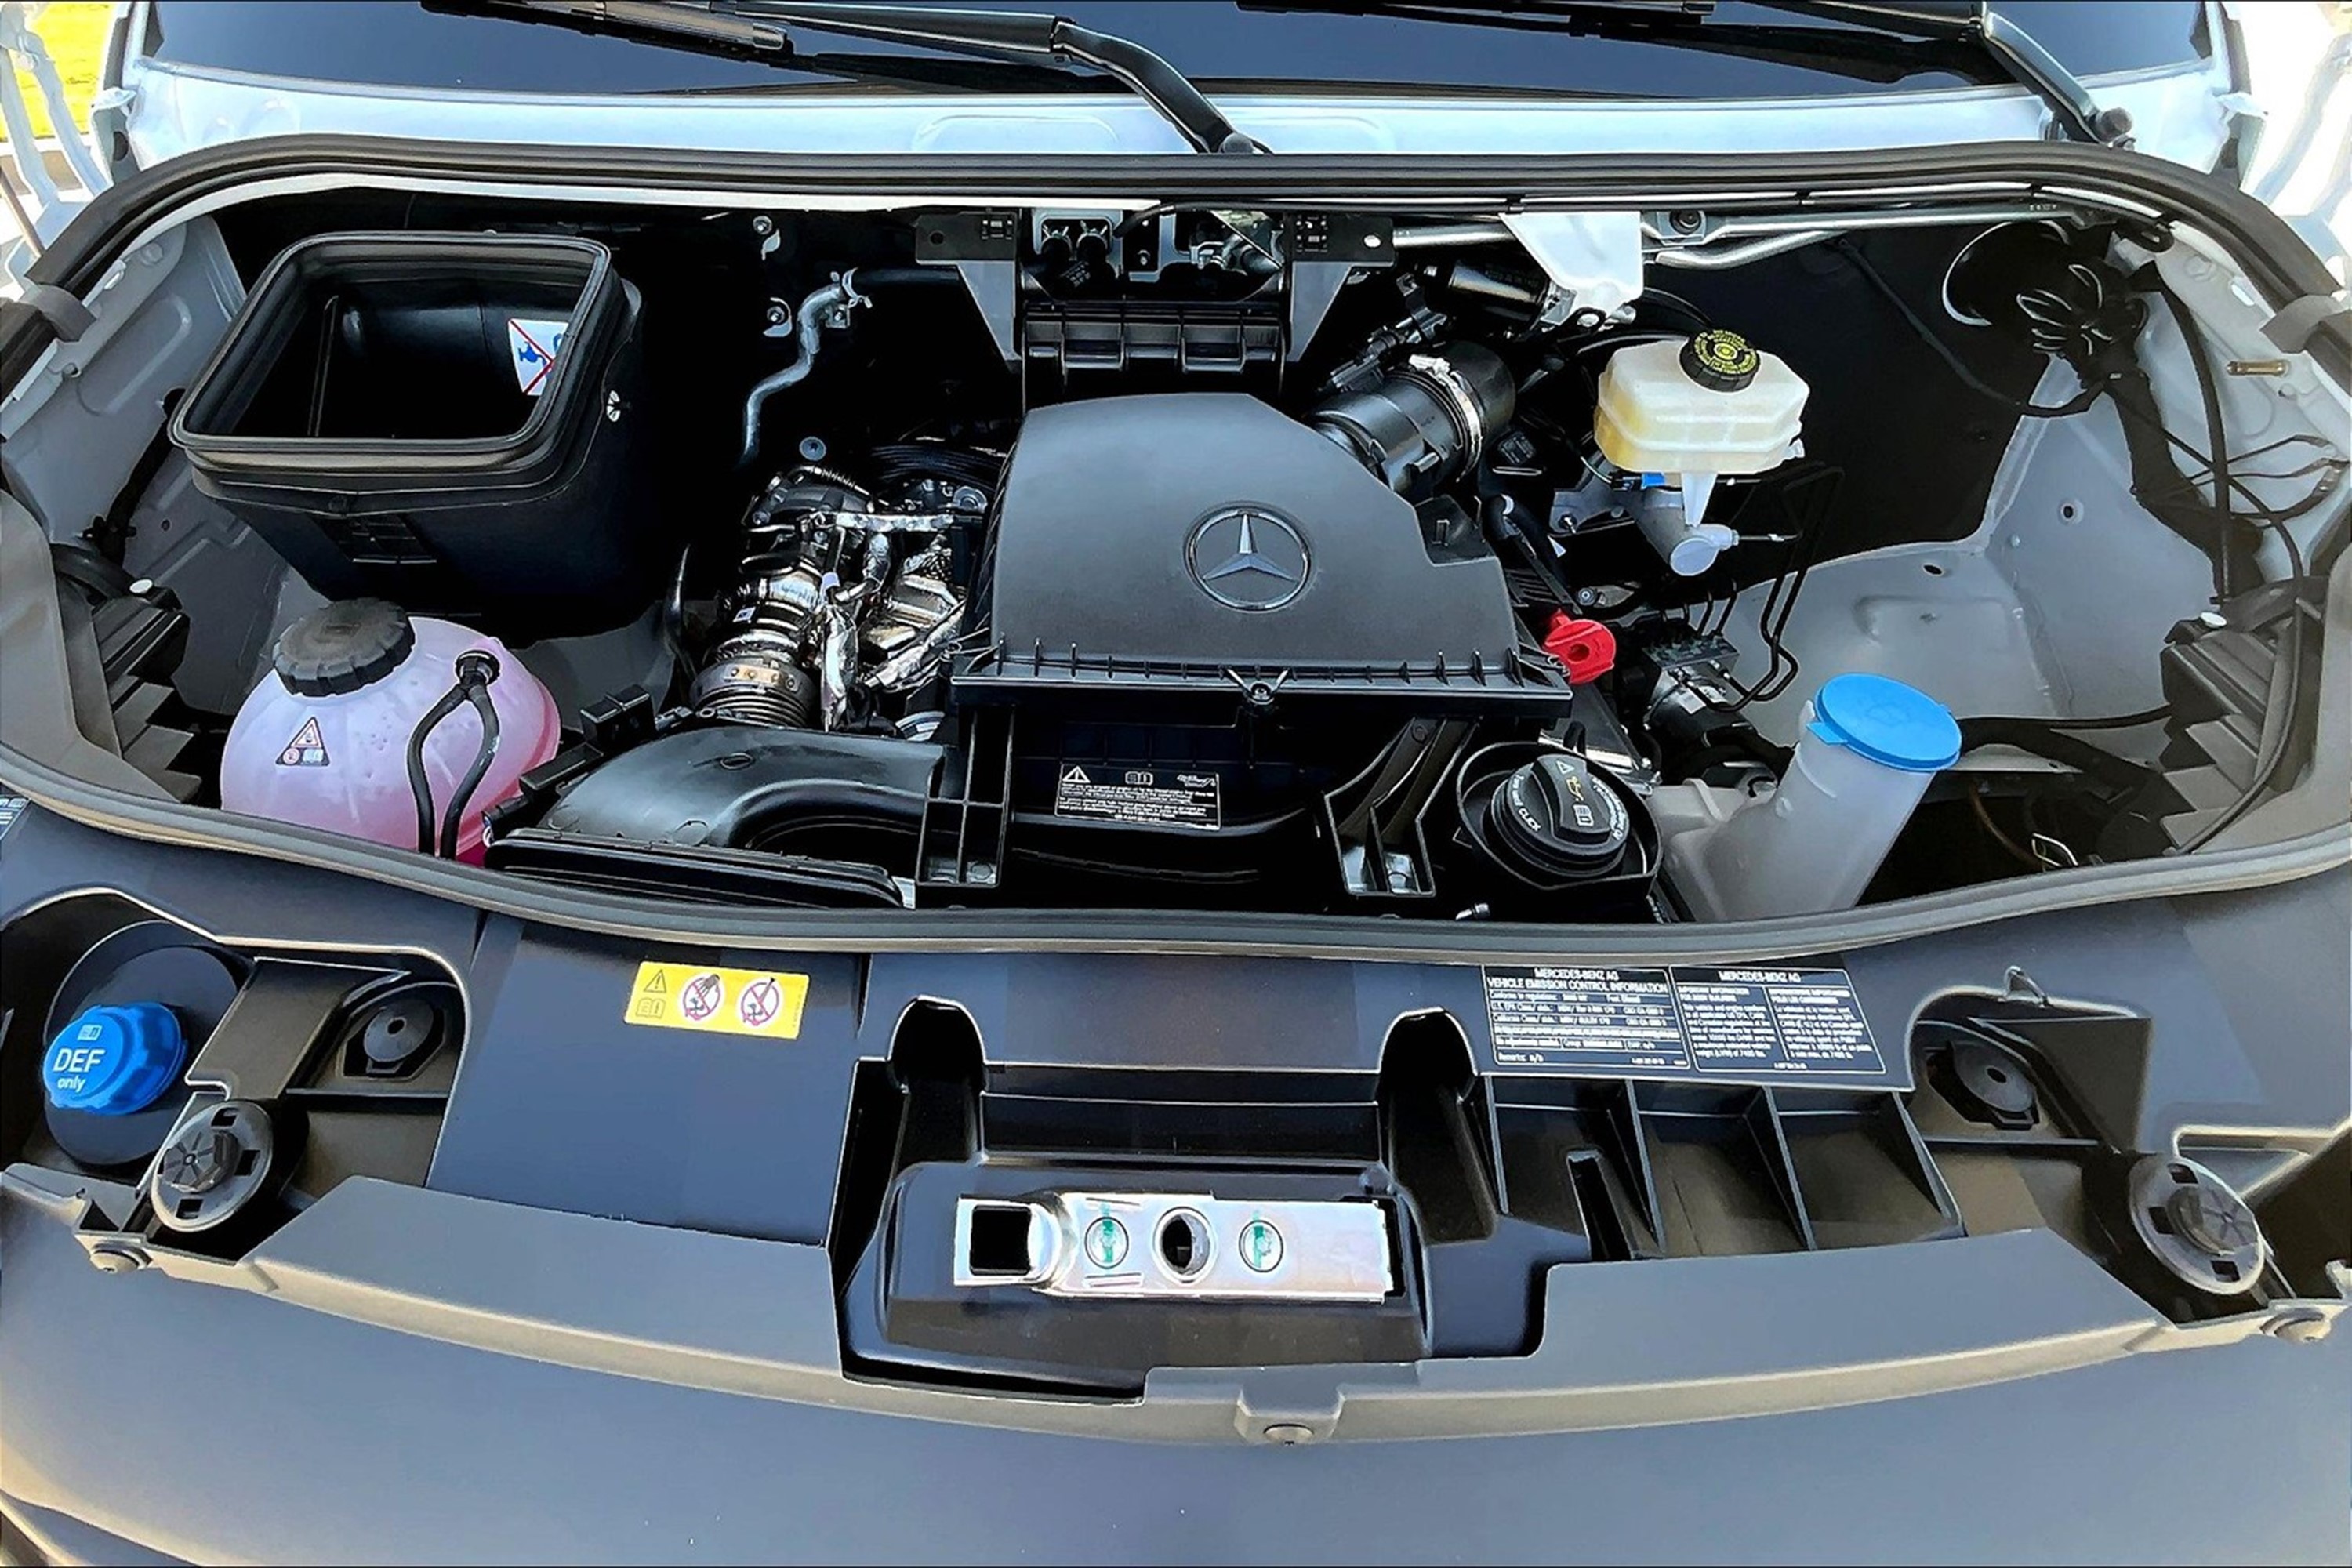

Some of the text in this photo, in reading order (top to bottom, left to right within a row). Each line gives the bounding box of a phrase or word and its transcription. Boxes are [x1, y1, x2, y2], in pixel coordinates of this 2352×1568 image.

[1534, 967, 1605, 981] MERCEDES-BENZ
[1718, 970, 1802, 983] MERCEDES-BENZ AG
[1486, 977, 1669, 993] VEHICLE EMISSION CONTROL INFORMATION
[53, 1047, 106, 1073] DEF
[57, 1076, 86, 1092] only
